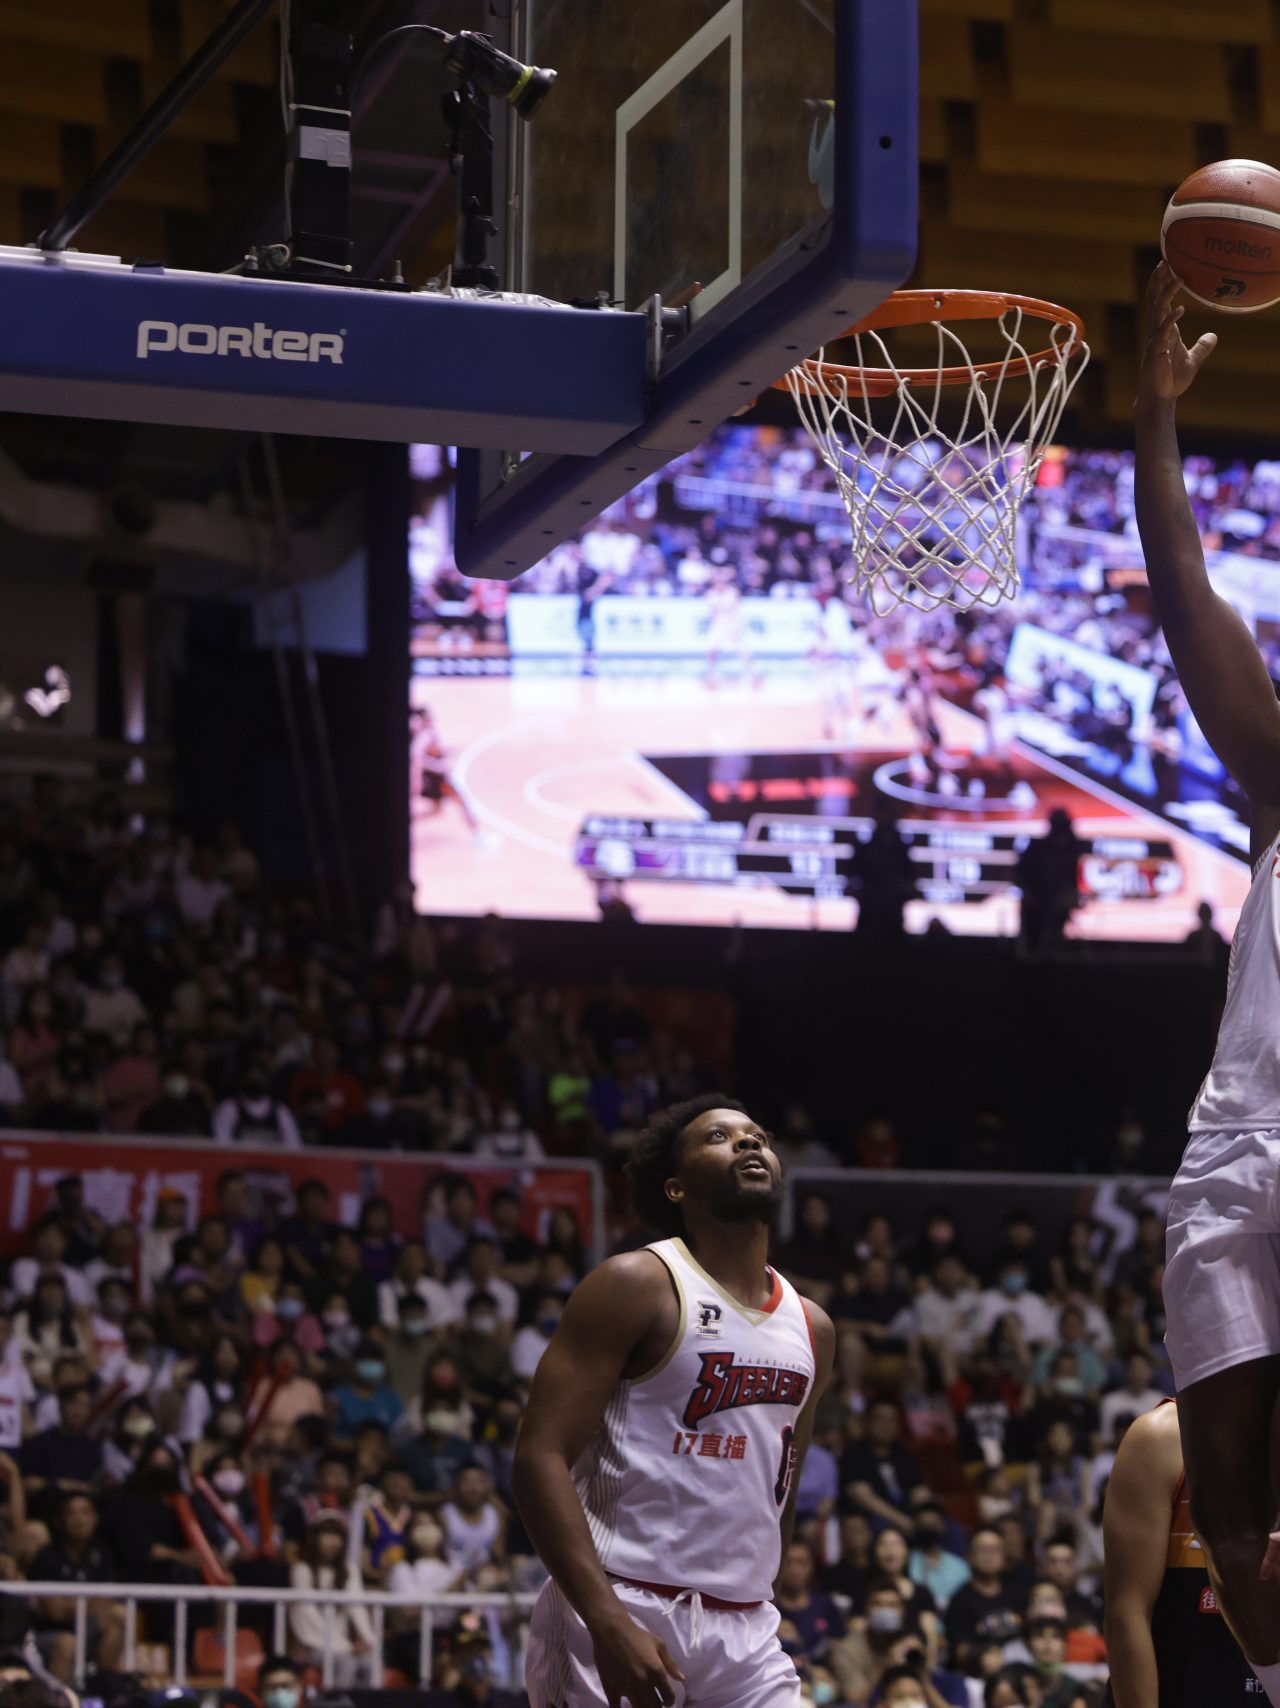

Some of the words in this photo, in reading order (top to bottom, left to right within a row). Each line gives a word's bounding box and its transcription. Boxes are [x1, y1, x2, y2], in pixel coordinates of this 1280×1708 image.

[1204, 237, 1272, 260] molten
[683, 1352, 809, 1430] STEELERS
[673, 1432, 747, 1460] 17直播
